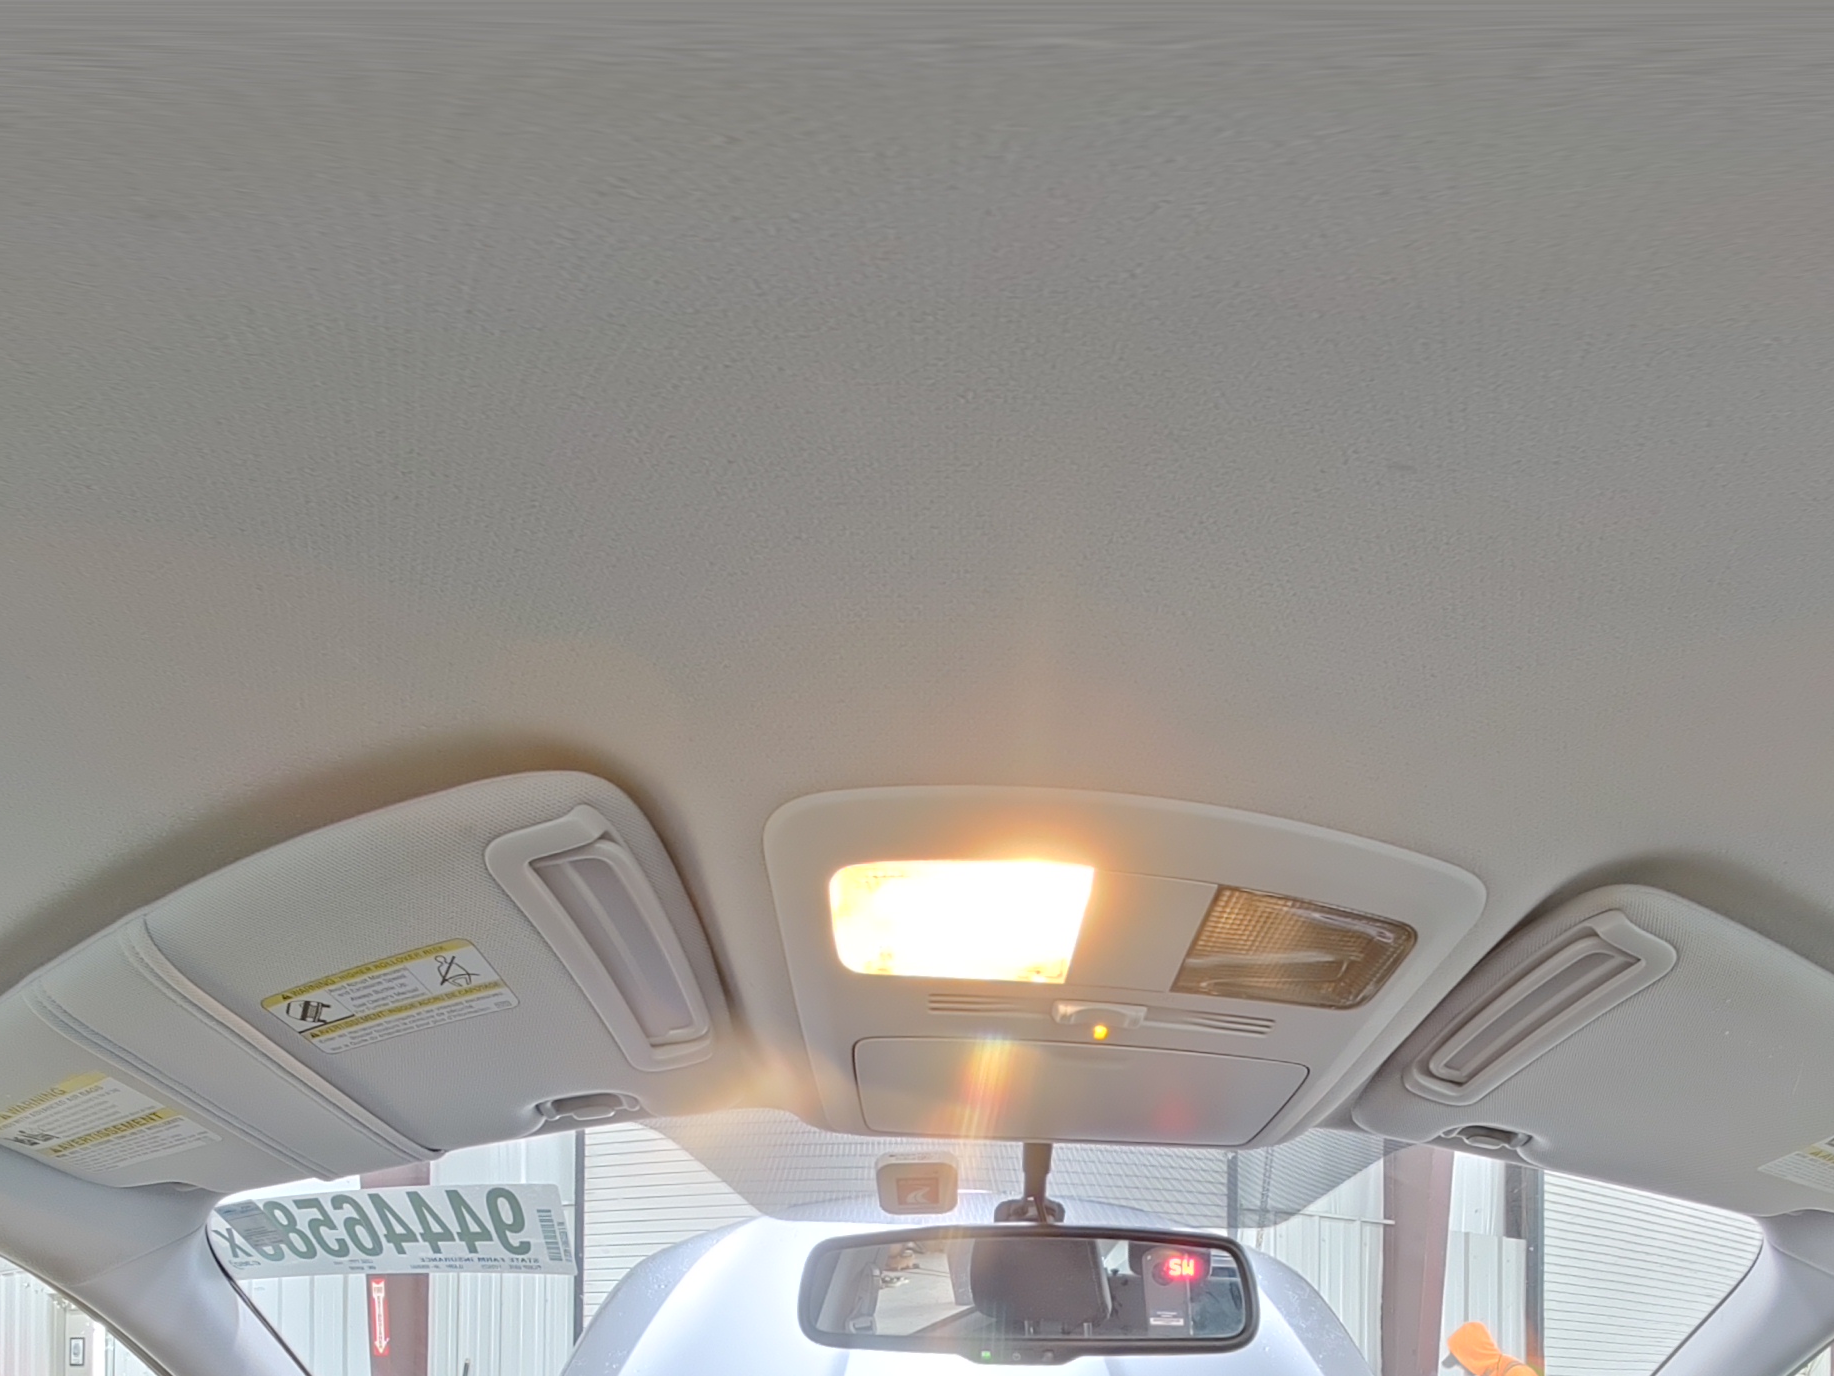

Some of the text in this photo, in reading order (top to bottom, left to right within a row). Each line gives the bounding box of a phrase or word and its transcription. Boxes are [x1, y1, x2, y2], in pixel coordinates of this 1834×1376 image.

[7, 1087, 65, 1119] WARNING
[61, 1111, 164, 1151] AVERTISSEMENT
[1168, 1258, 1195, 1277] SW
